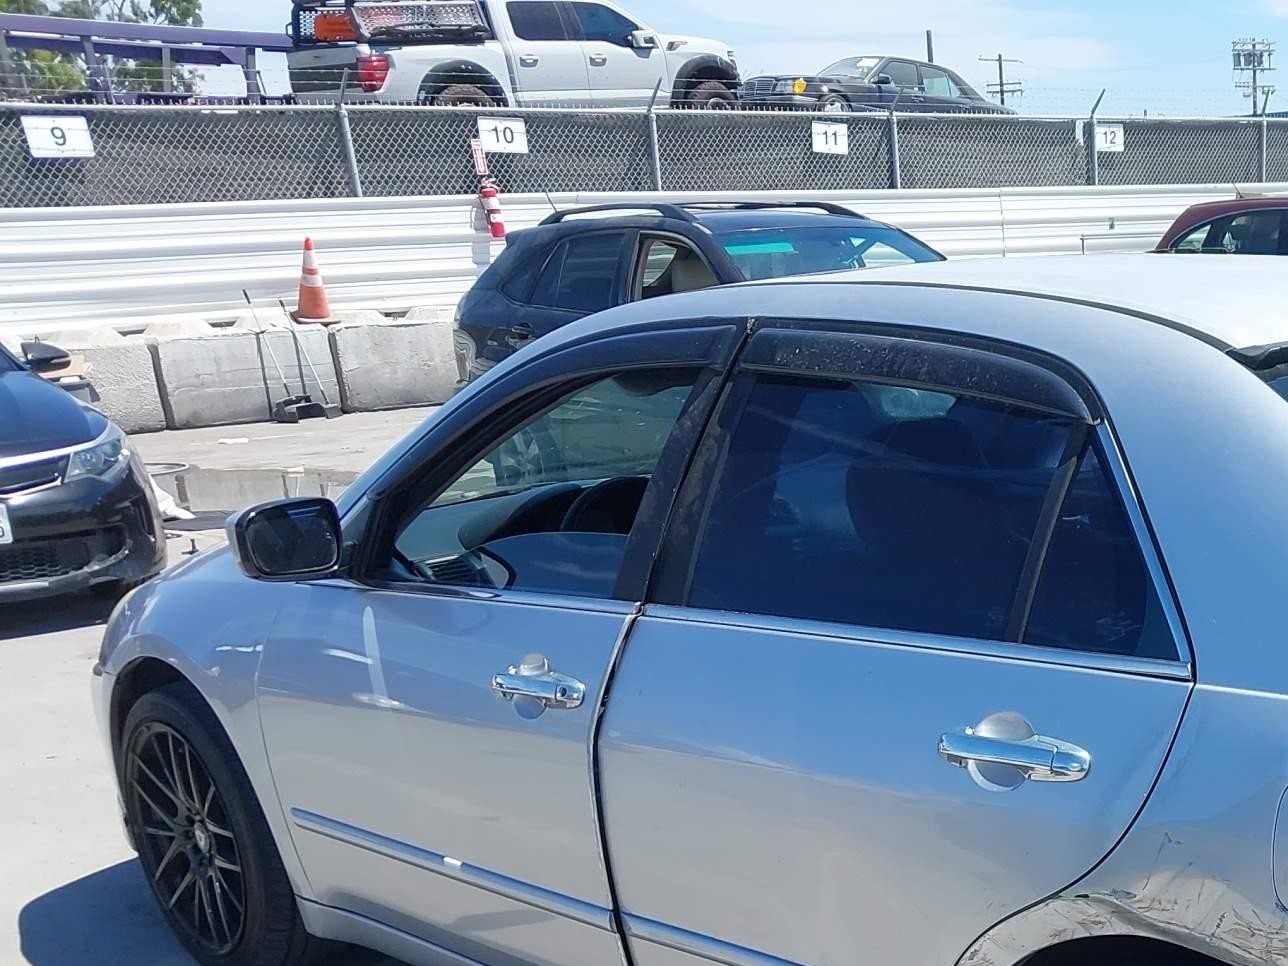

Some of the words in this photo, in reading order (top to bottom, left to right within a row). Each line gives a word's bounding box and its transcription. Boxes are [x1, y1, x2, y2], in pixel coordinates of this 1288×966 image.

[50, 126, 67, 146] 9
[491, 125, 514, 144] 10
[822, 130, 838, 146] 11
[1103, 130, 1117, 145] 12
